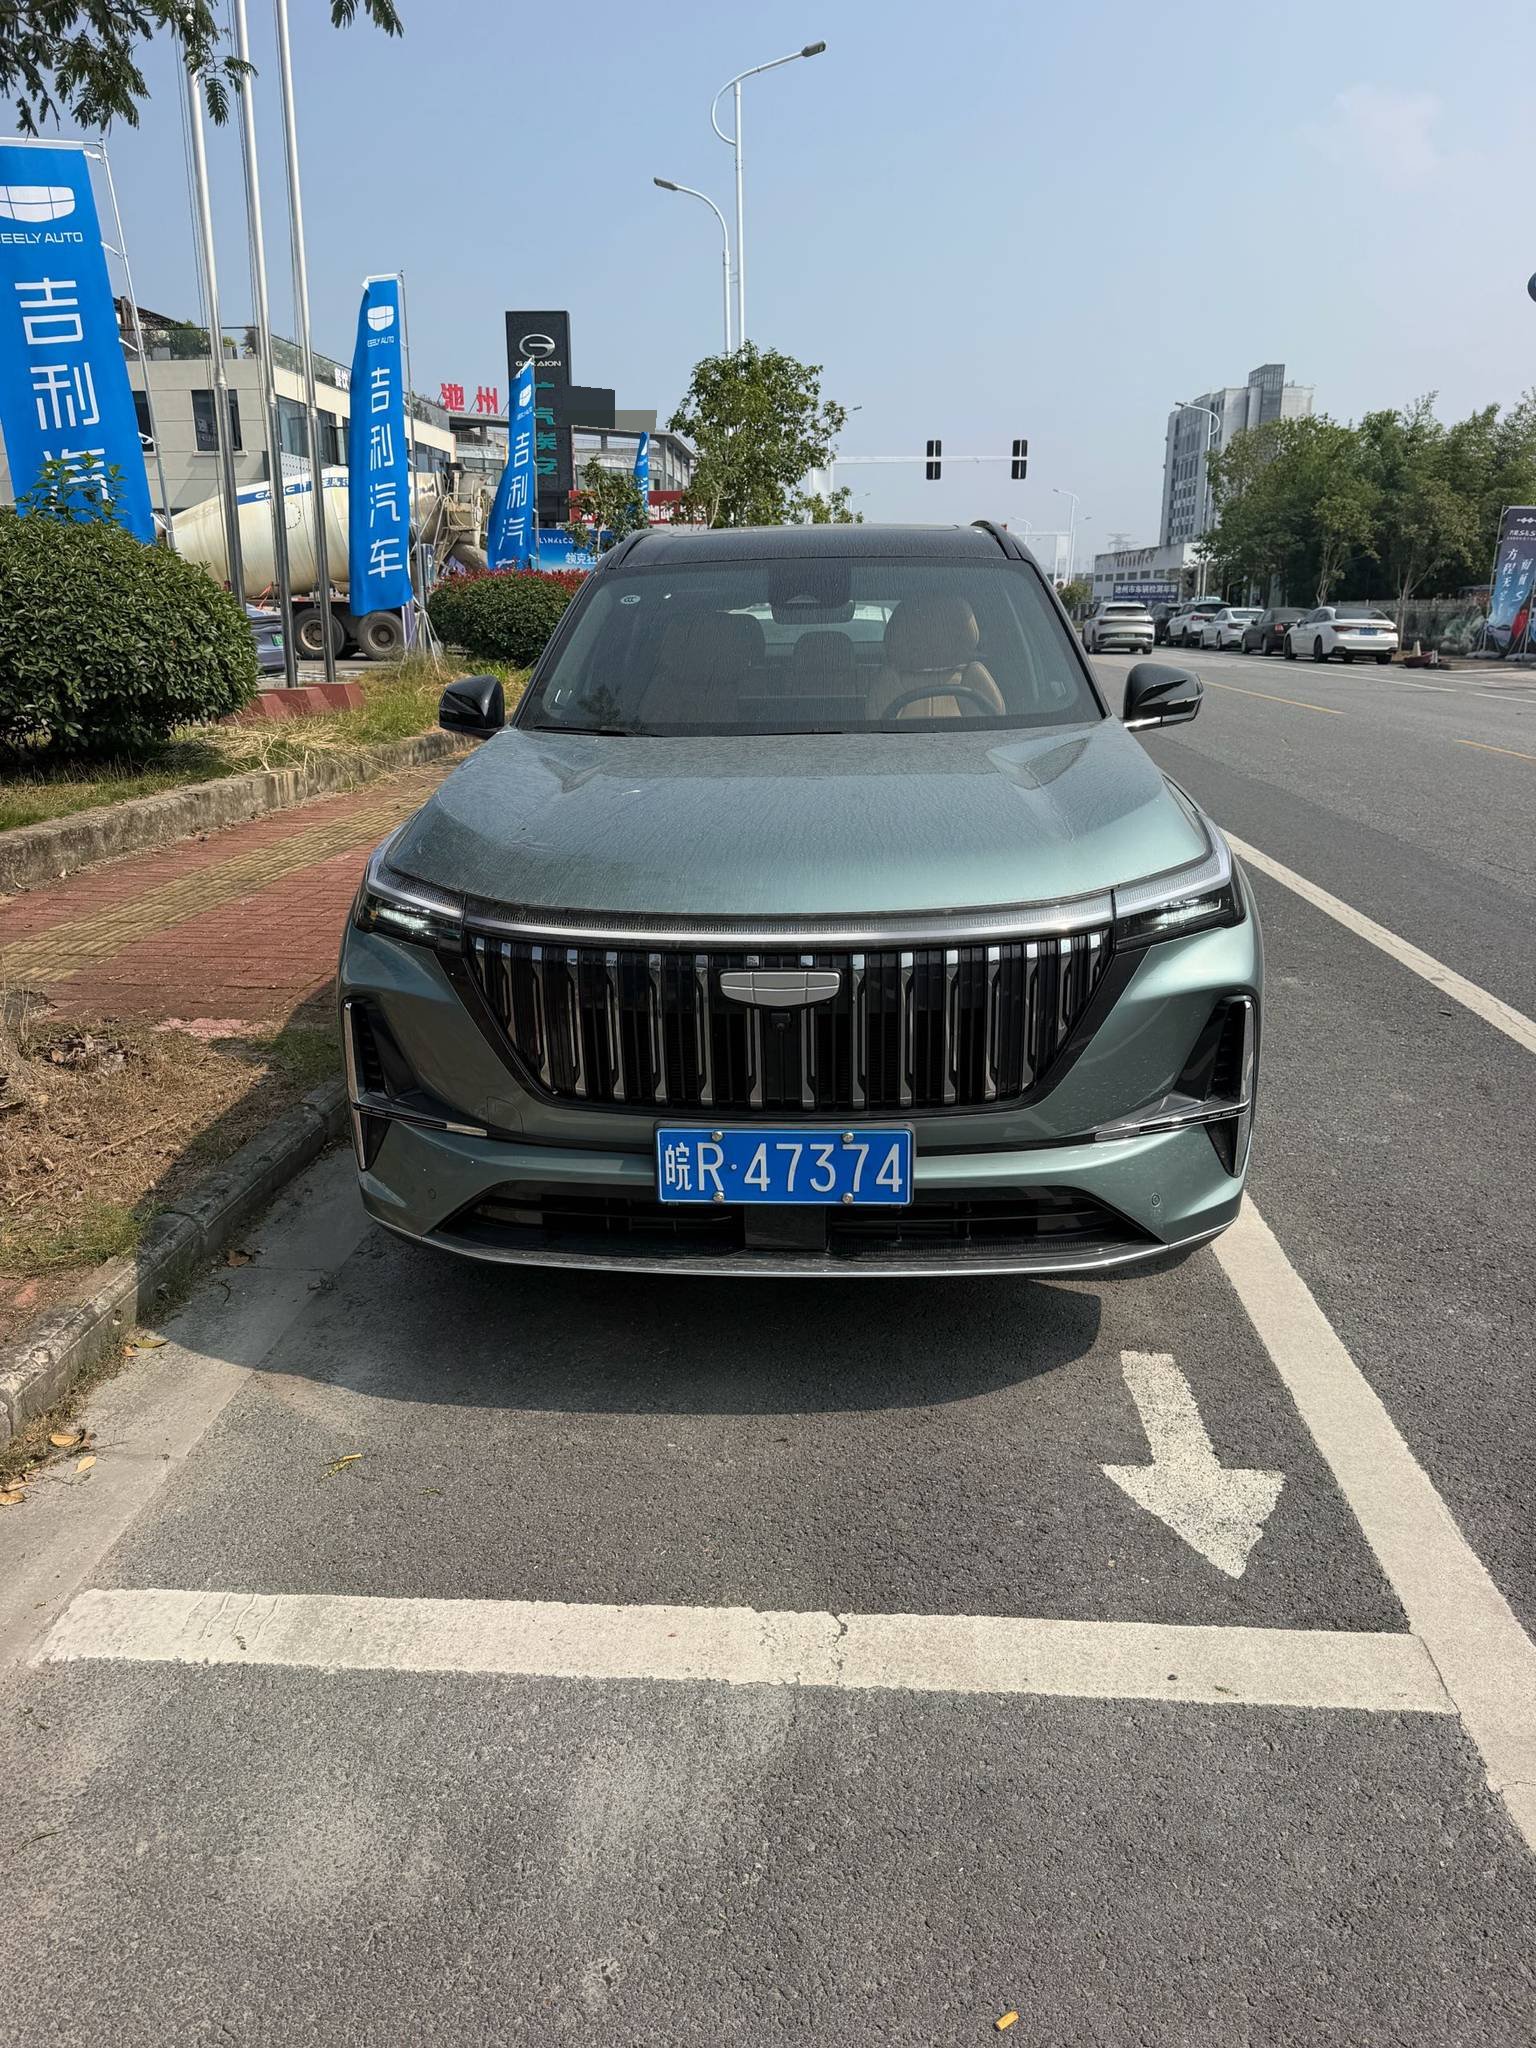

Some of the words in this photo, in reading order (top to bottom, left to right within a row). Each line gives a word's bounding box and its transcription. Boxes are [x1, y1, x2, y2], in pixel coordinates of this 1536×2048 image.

[0, 233, 41, 244] EELY
[44, 232, 83, 243] AUTO
[368, 366, 403, 578] 吉利汽车
[664, 1141, 903, 1193] 皖R·47374
